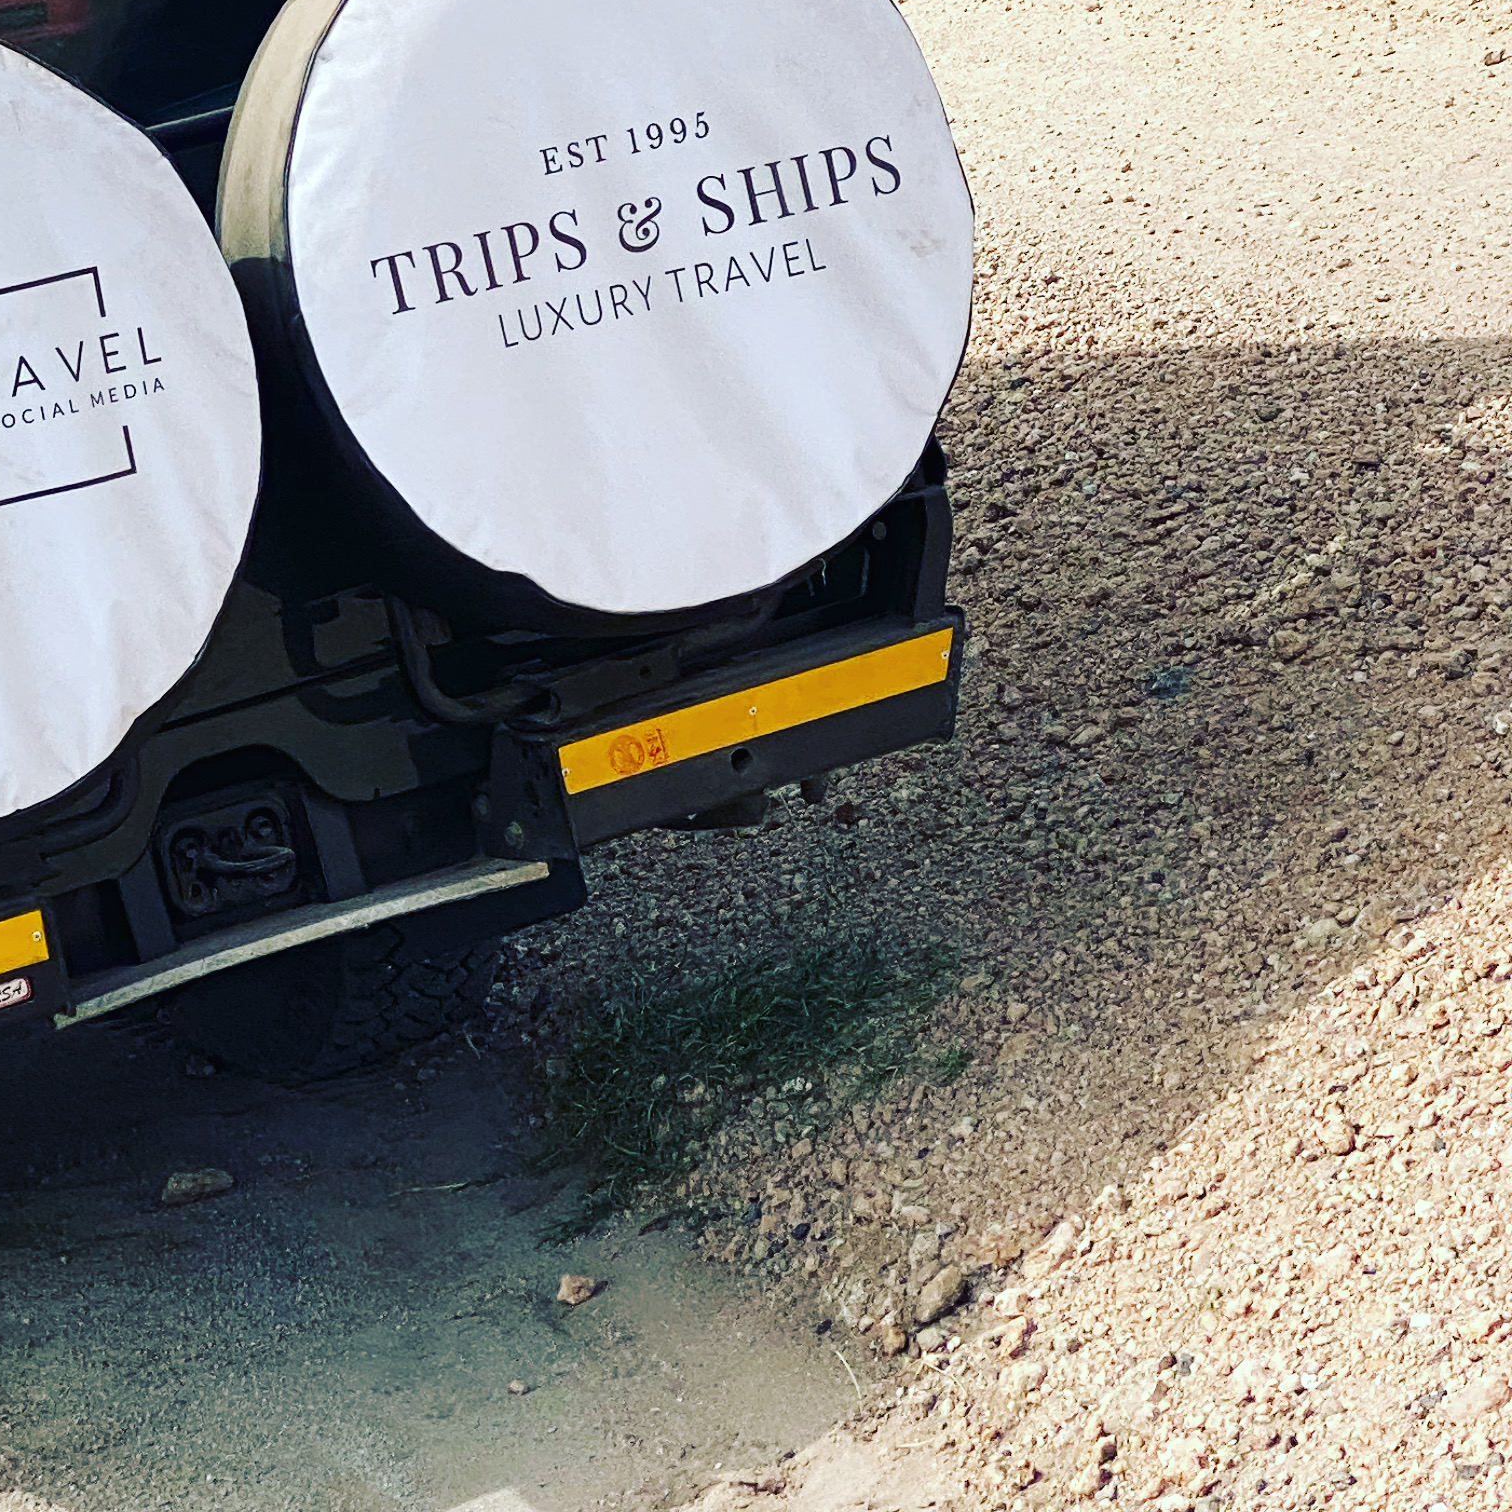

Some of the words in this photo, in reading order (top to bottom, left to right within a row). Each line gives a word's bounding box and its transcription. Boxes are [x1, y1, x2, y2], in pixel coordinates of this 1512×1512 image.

[538, 134, 608, 176] EST
[626, 111, 710, 155] 1995
[370, 208, 587, 315] TRIPS
[616, 196, 662, 254] &
[696, 134, 902, 237] SHIPS
[498, 275, 652, 348] LUXURY
[664, 238, 827, 303] TRAVEL
[89, 377, 166, 409] MEDIA
